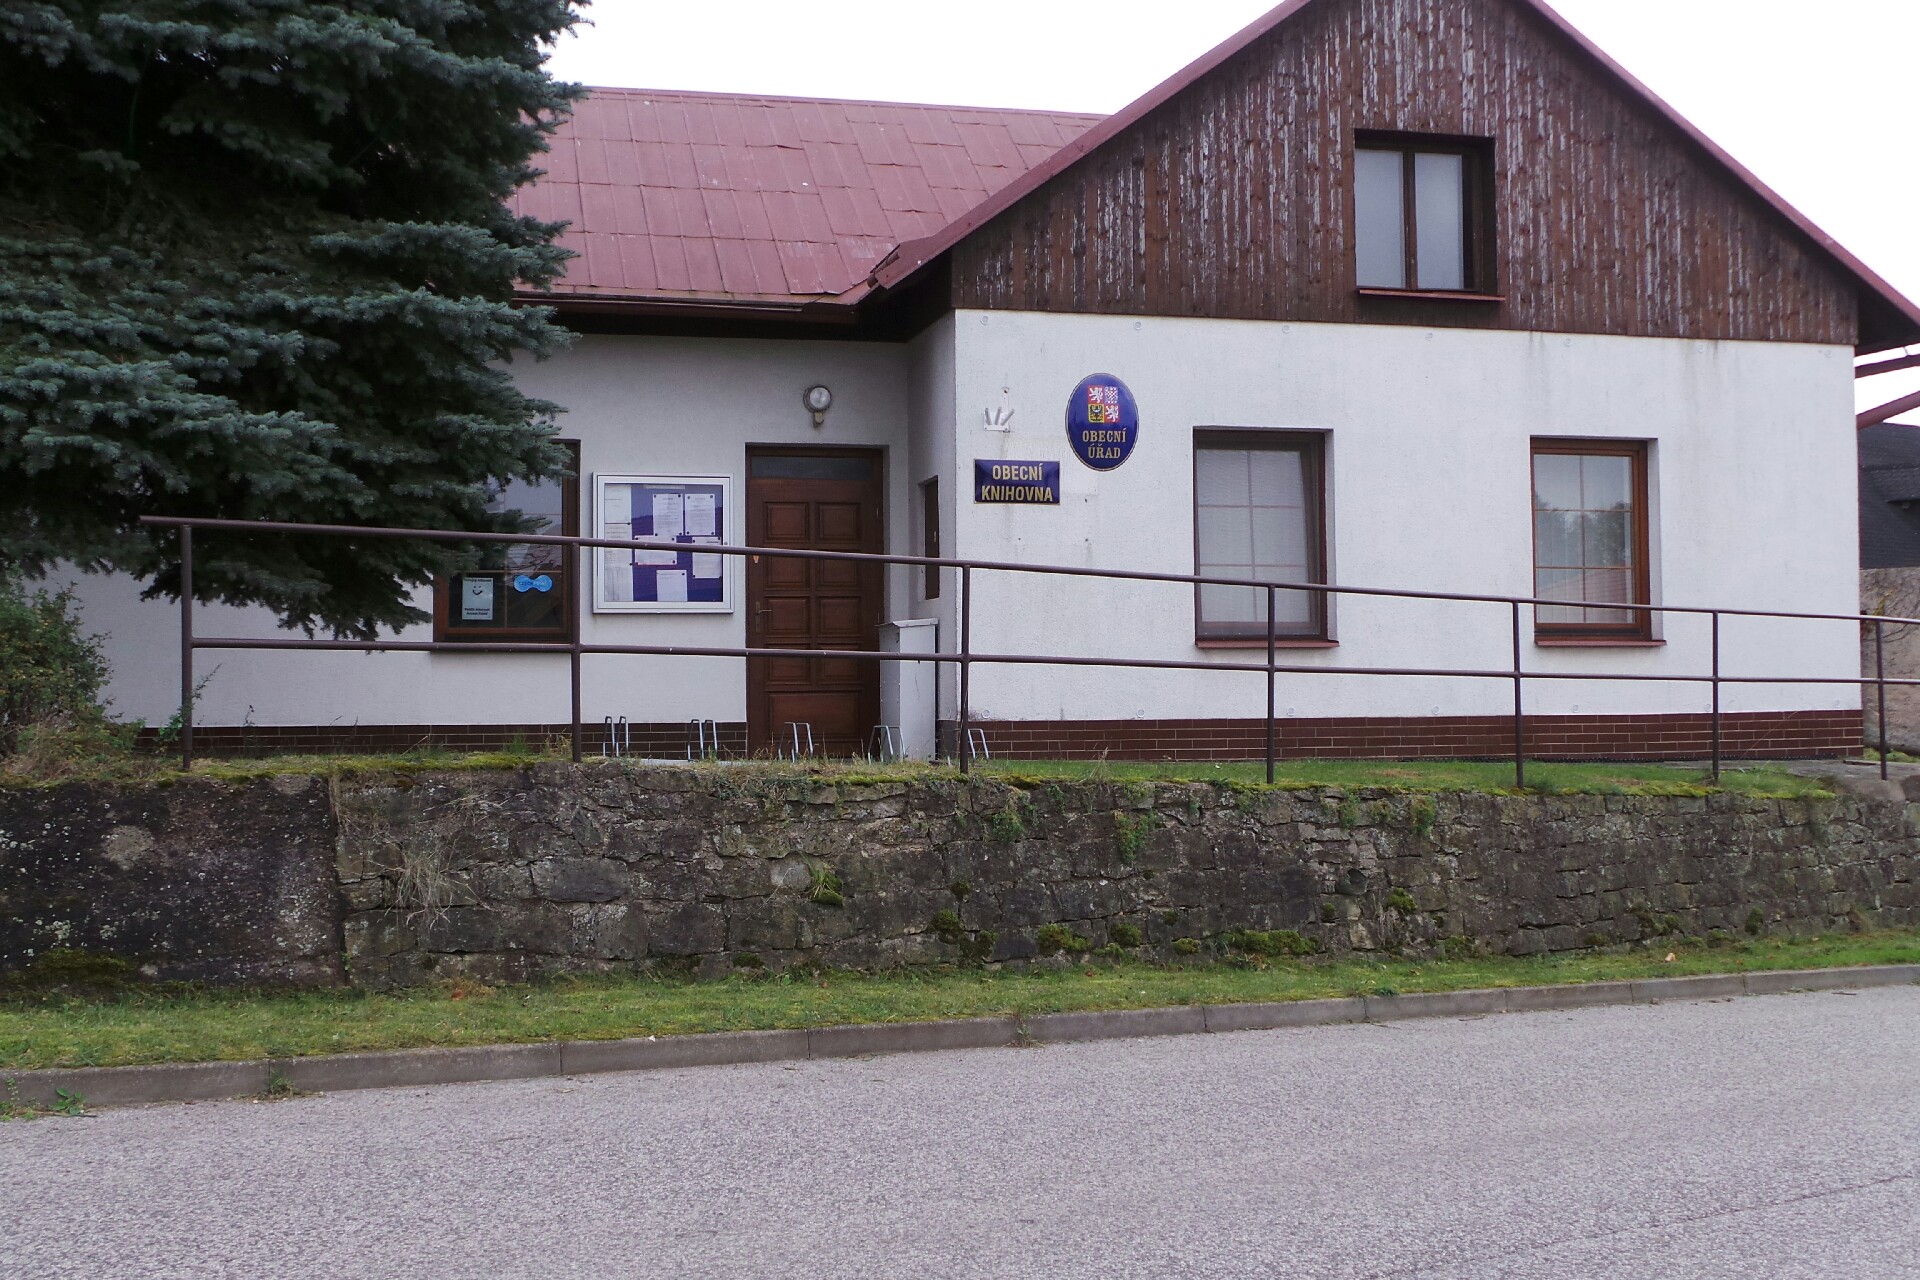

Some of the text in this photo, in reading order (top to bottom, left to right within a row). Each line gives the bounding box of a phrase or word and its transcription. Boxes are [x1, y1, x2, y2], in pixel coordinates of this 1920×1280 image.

[1082, 427, 1127, 443] OBECNÍ
[1088, 443, 1121, 459] ÚŘAD
[992, 463, 1043, 481] OBECNÍ
[981, 485, 1053, 502] KNIHOVNA
